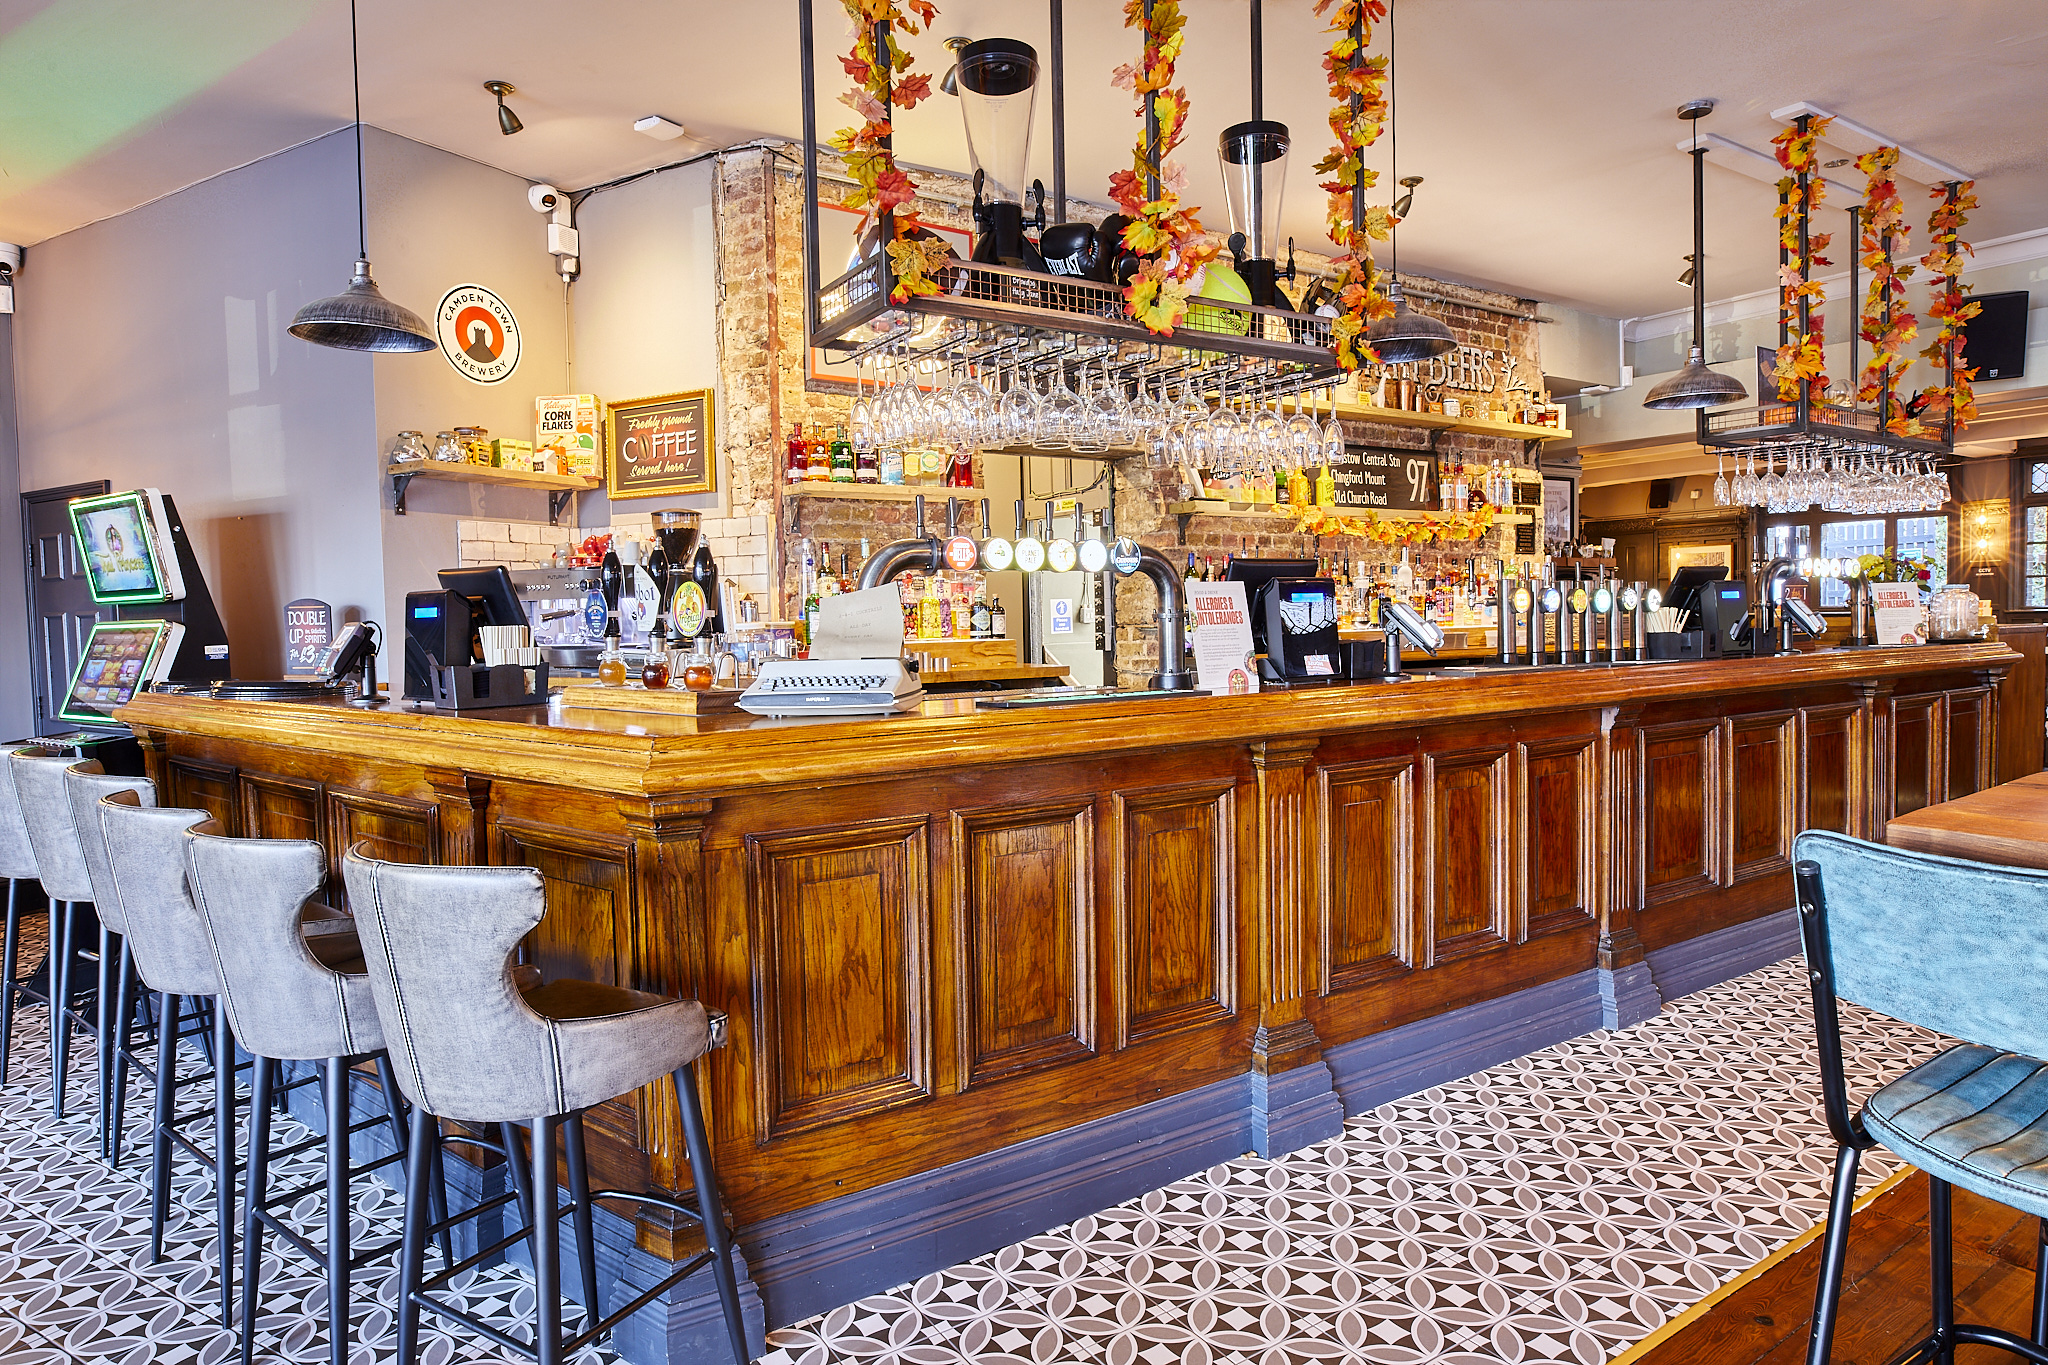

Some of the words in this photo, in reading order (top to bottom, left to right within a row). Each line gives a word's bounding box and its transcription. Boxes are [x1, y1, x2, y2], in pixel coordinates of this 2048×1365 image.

[1044, 252, 1085, 276] EVERLAST
[445, 294, 484, 320] CAMDEN
[489, 300, 512, 333] TOWN
[455, 352, 507, 375] BREWERY
[544, 411, 571, 420] CORN
[628, 415, 660, 433] Freshly
[662, 412, 693, 430] ground
[543, 421, 573, 430] FLAKES
[1344, 453, 1360, 464] stow
[1362, 452, 1387, 466] Central
[1389, 454, 1401, 467] Stn
[630, 461, 662, 477] Served
[664, 458, 691, 472] here!
[1331, 469, 1363, 486] Chingford
[1365, 471, 1386, 485] Mount
[1406, 458, 1429, 502] 97
[1334, 490, 1346, 504] Old
[1347, 490, 1369, 505] Church
[1370, 491, 1387, 506] Road
[1785, 588, 1790, 600] 2
[1803, 587, 1806, 600] 1
[856, 606, 882, 615] COCKTAILS
[1195, 597, 1228, 610] ALLERGIES
[1228, 597, 1234, 610] &
[1879, 600, 1915, 608] INTOLERANCES
[287, 611, 326, 625] DOUBLE
[678, 612, 701, 626] Tropical
[1197, 611, 1244, 625] INTOLERANCES
[289, 629, 304, 644] UP
[305, 635, 326, 643] SPIRITS
